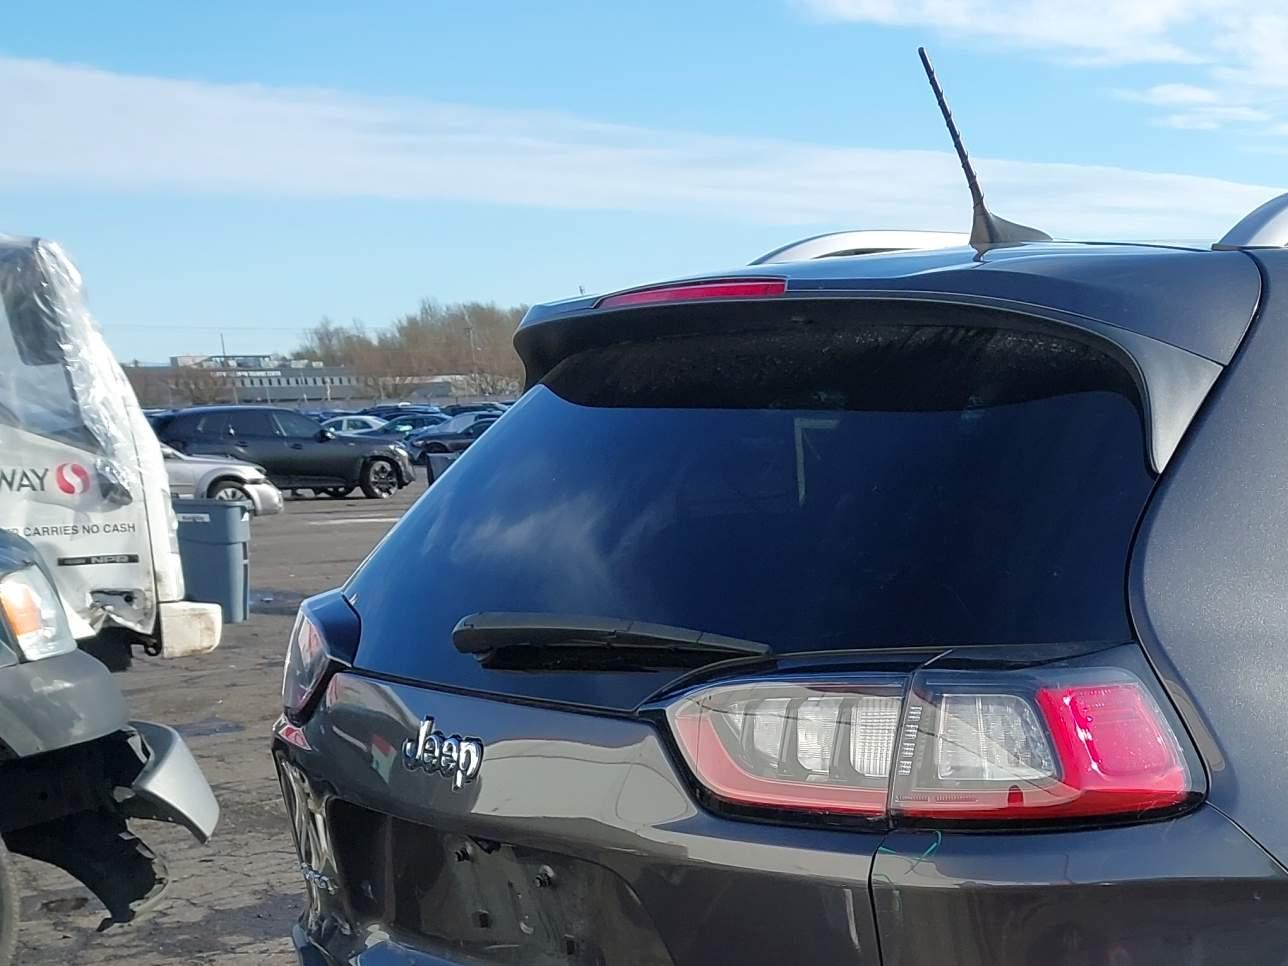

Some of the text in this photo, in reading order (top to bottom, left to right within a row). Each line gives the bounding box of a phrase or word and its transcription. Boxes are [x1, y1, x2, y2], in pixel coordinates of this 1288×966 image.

[23, 525, 79, 537] CARRIES
[82, 524, 99, 534] NO
[103, 523, 136, 533] CASH
[402, 715, 483, 789] Jeep
